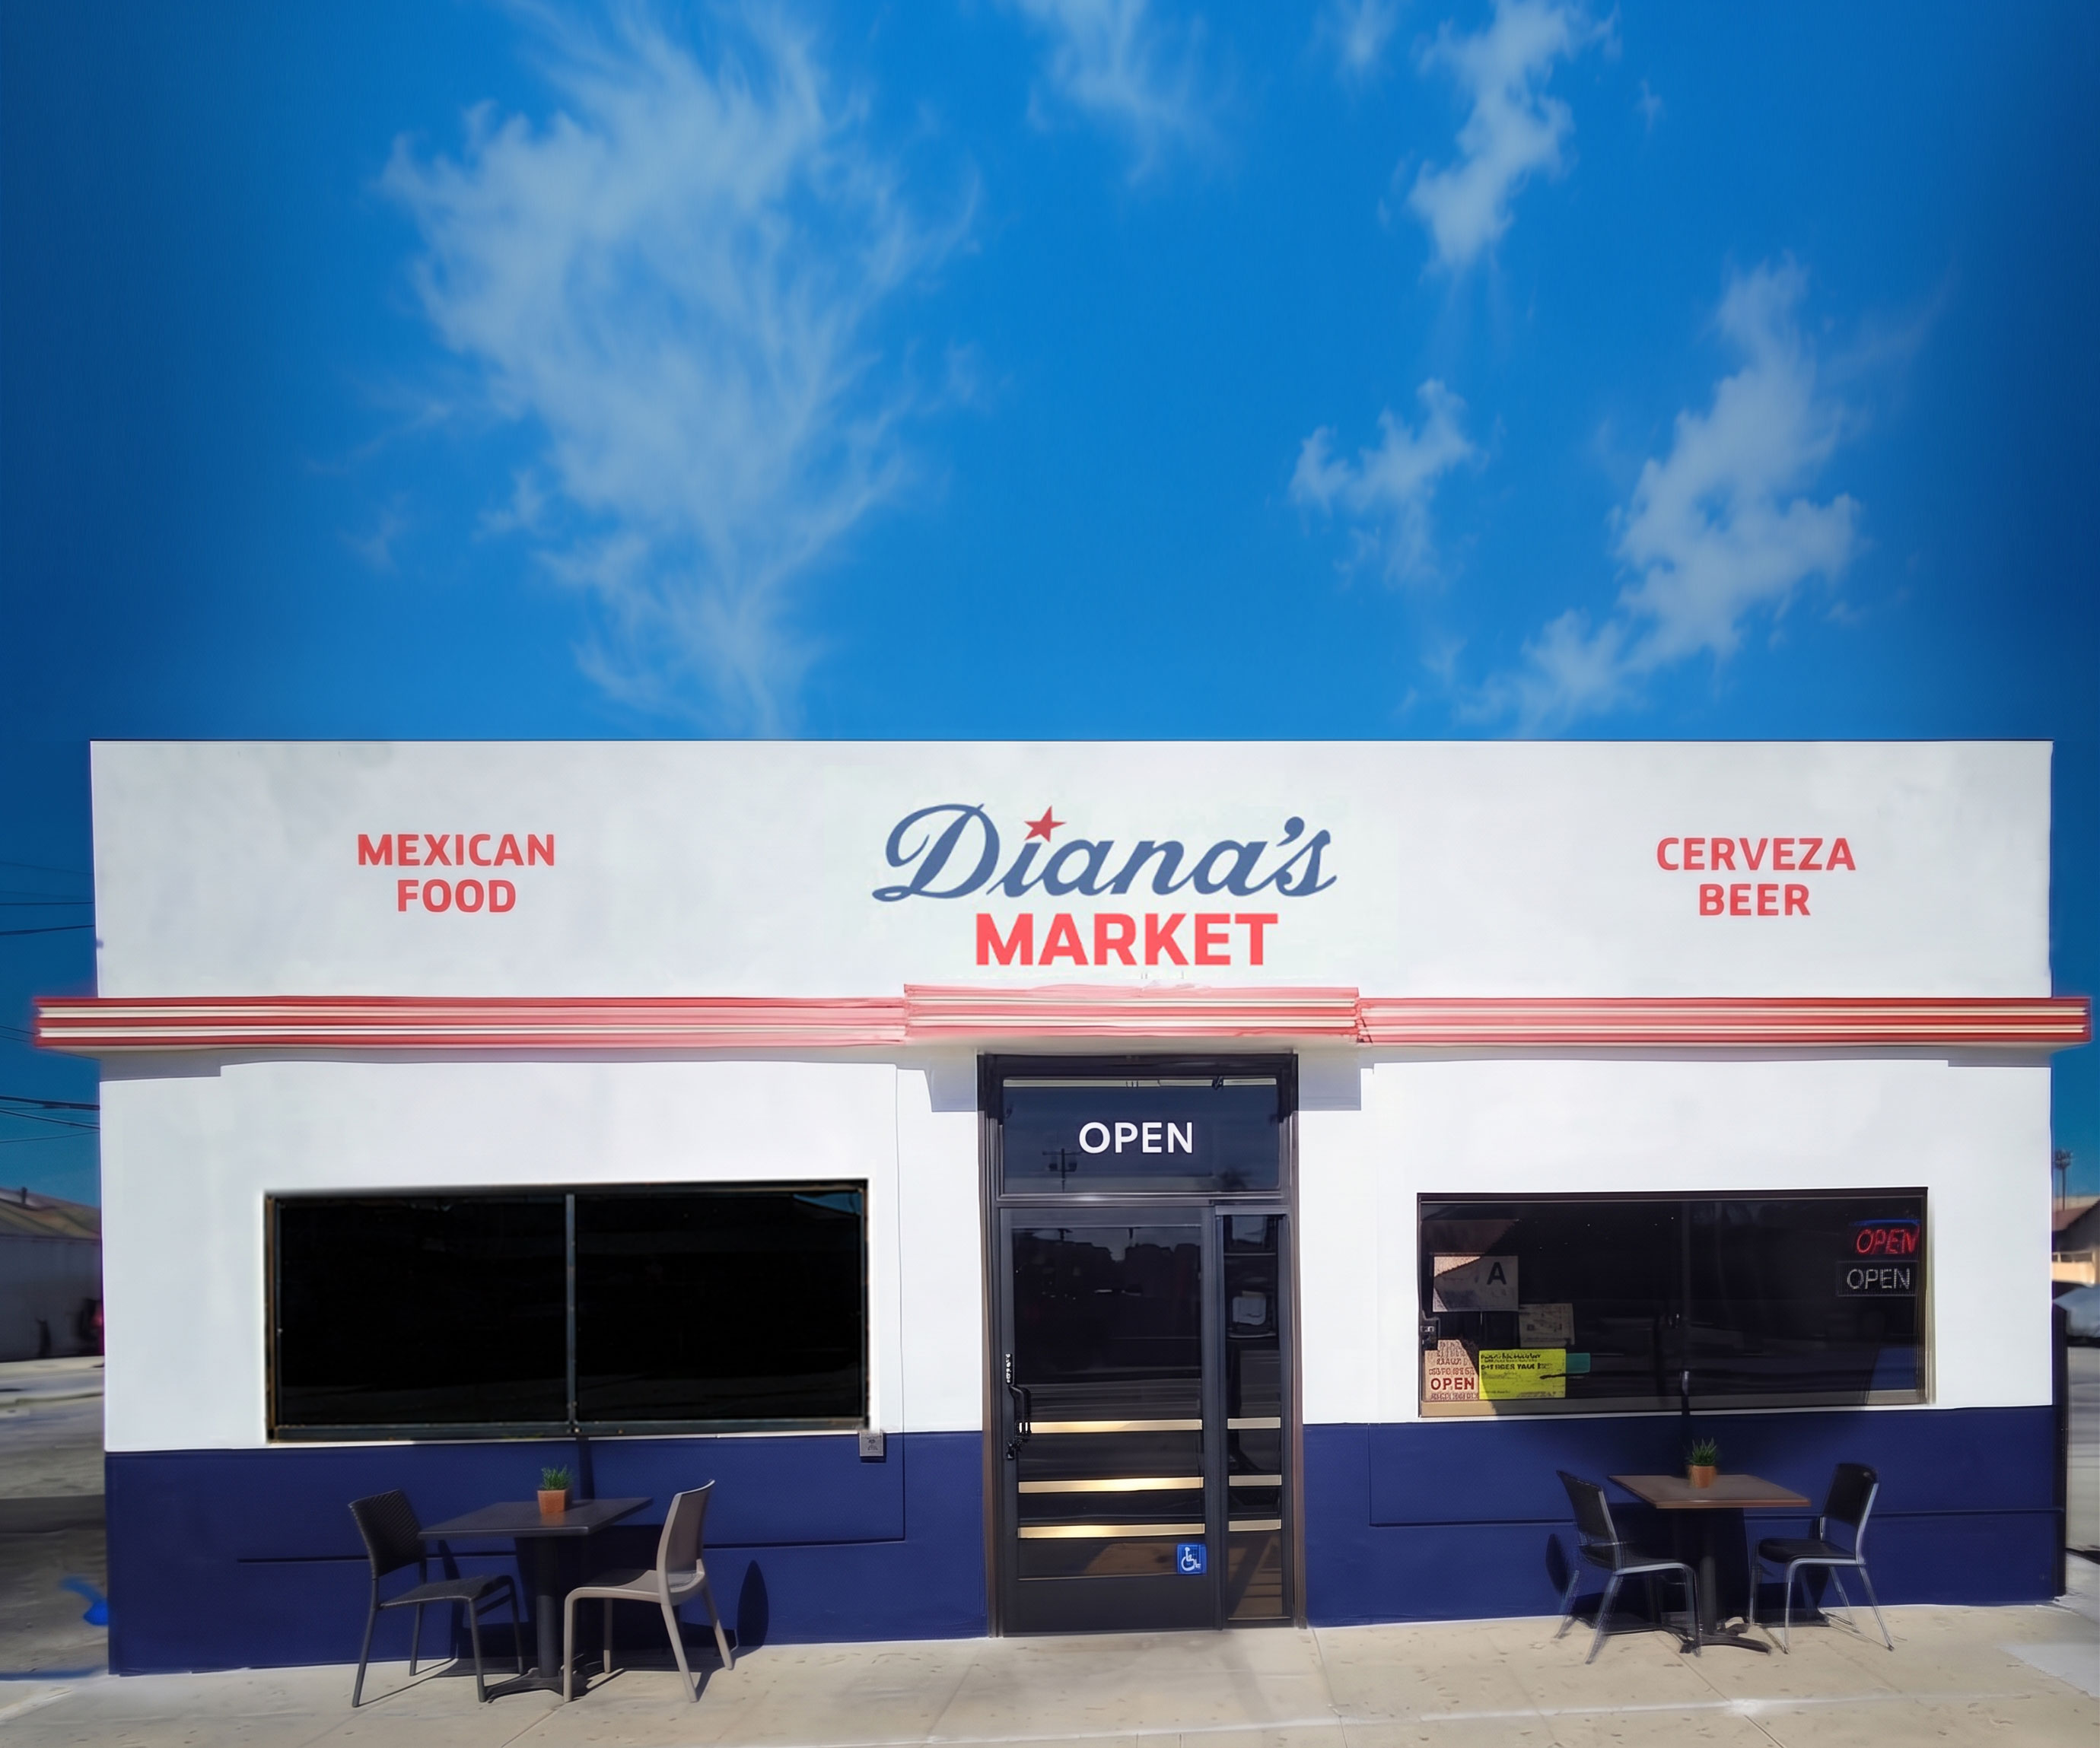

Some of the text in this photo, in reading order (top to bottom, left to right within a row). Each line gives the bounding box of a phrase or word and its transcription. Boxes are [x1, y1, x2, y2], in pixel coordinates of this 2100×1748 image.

[358, 834, 555, 866] MEXICAN
[872, 803, 1337, 901] Diana's
[1656, 837, 1856, 870] CERVEZA
[397, 879, 516, 913] FOOD
[1699, 883, 1811, 916] BEER
[975, 913, 1278, 966] MARKET
[1079, 1122, 1193, 1154] OPEN
[1857, 1228, 1920, 1254] OPEN
[1486, 1262, 1507, 1285] A
[1847, 1268, 1910, 1289] OPEN
[1430, 1377, 1475, 1390] OPEN
